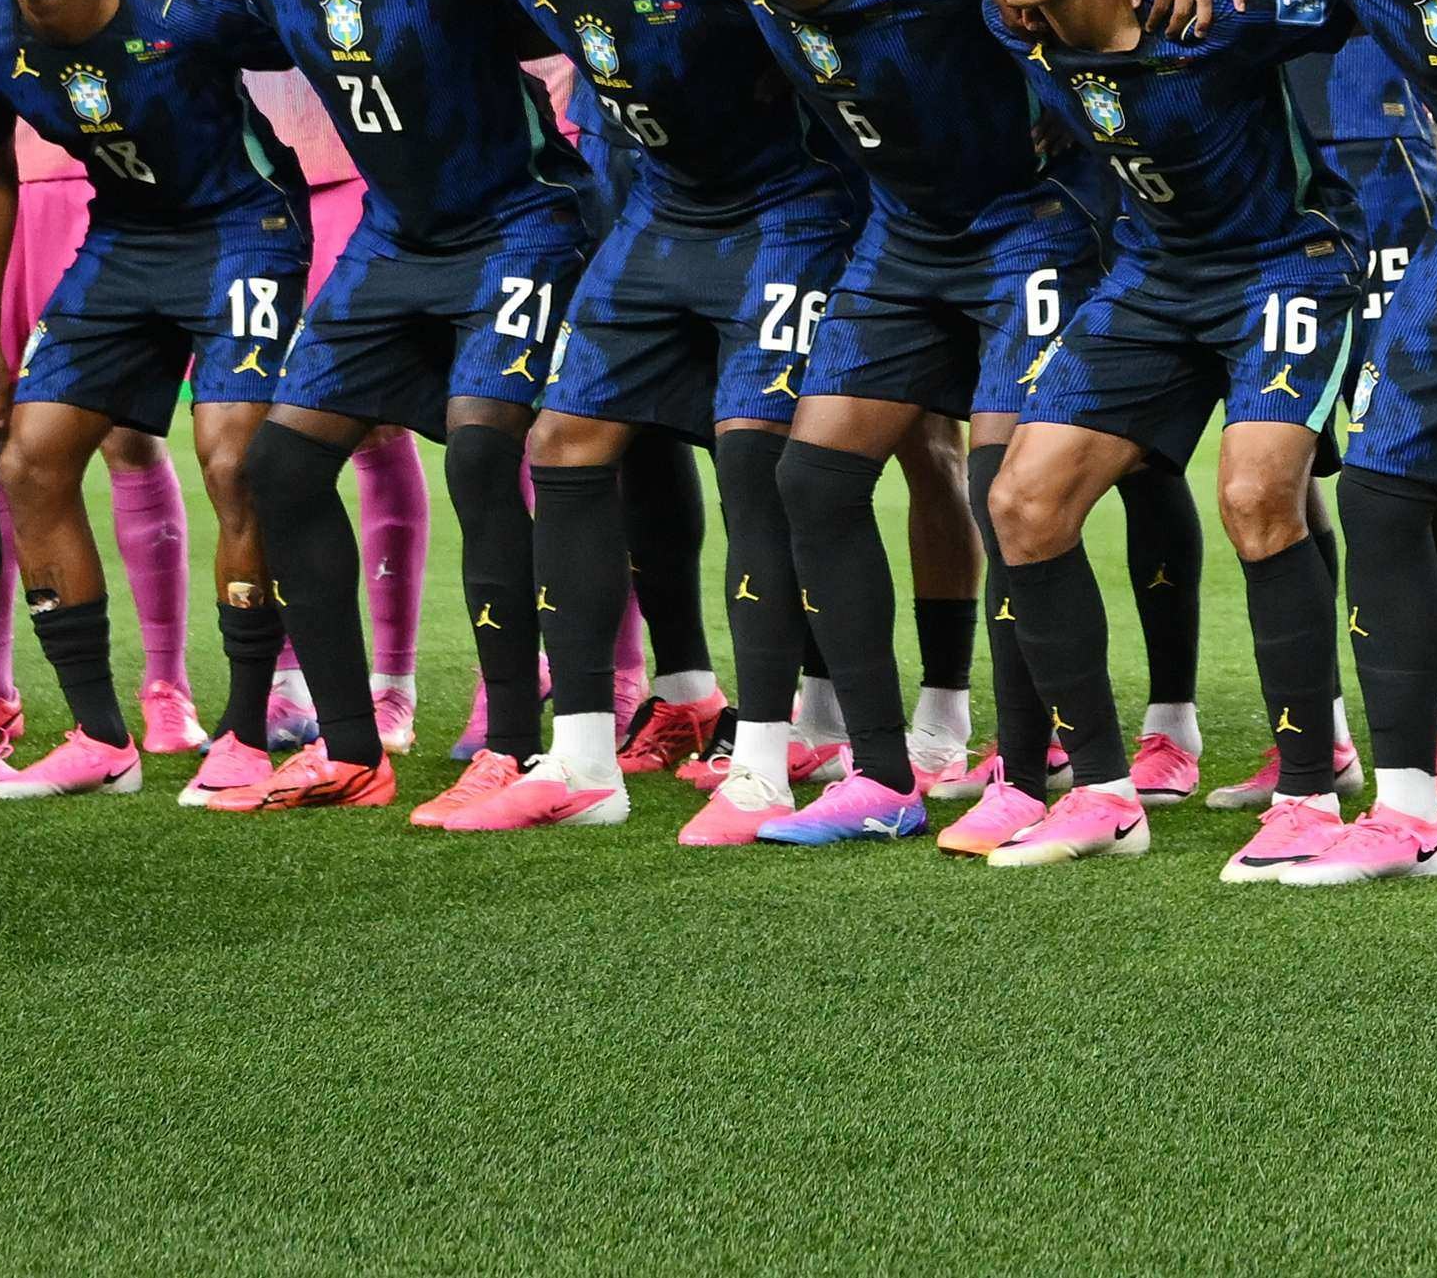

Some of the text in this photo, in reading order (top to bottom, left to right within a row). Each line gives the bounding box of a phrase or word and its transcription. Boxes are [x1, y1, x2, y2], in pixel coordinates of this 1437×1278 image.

[331, 49, 372, 62] BRASIL
[80, 121, 124, 134] BRASIL
[336, 75, 403, 133] 21
[838, 100, 882, 148] 6
[94, 140, 156, 184] 18
[1110, 155, 1175, 203] 16
[227, 277, 279, 341] 18
[494, 276, 552, 345] 21
[1025, 268, 1060, 336] 6
[1262, 292, 1318, 355] 16
